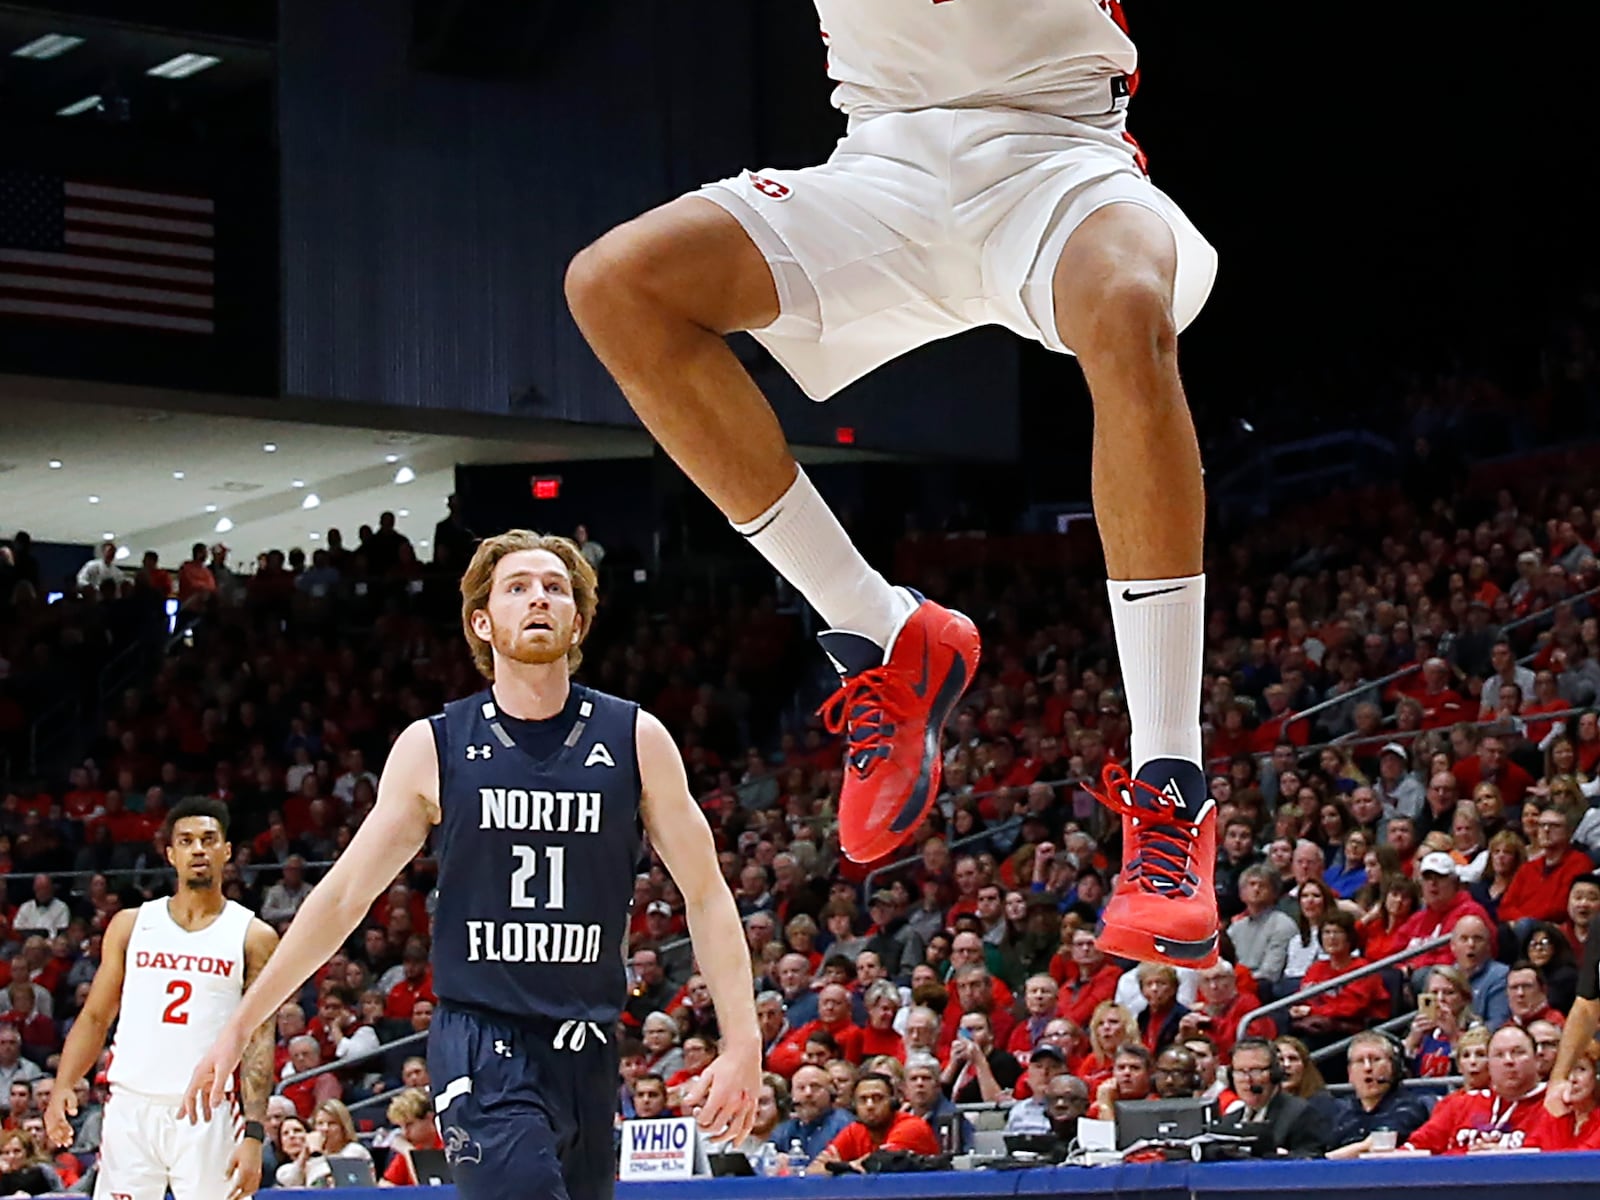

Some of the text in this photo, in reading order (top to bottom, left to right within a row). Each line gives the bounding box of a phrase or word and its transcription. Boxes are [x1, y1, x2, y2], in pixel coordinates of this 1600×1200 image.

[479, 788, 602, 833] NORTH
[510, 845, 565, 909] 21
[466, 921, 602, 963] FLORIDA
[136, 951, 235, 977] DAYTON
[162, 979, 193, 1025] 2
[631, 1123, 688, 1151] WHIO
